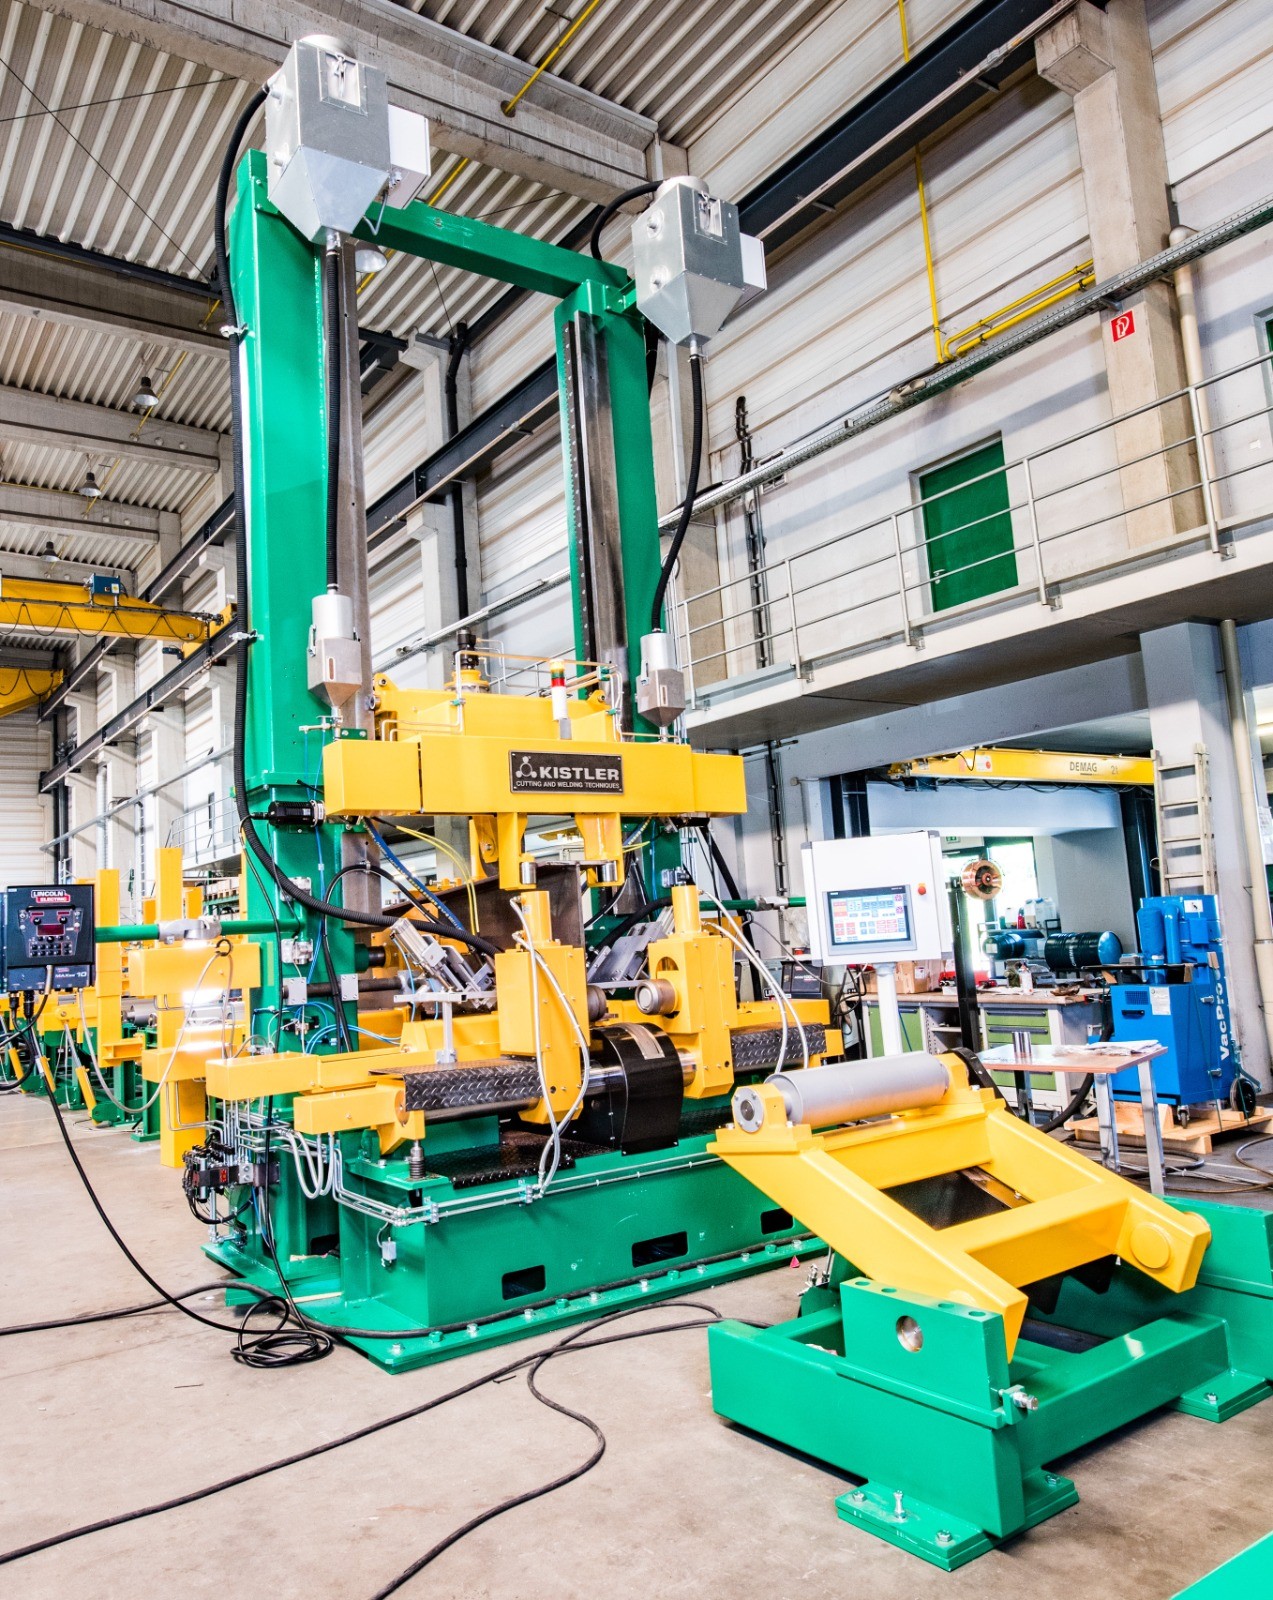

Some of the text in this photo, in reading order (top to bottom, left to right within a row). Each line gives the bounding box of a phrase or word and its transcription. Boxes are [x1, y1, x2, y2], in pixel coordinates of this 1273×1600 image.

[539, 766, 619, 780] KISTLER
[1069, 761, 1097, 772] DEMAG
[1216, 982, 1229, 1061] VacPro
